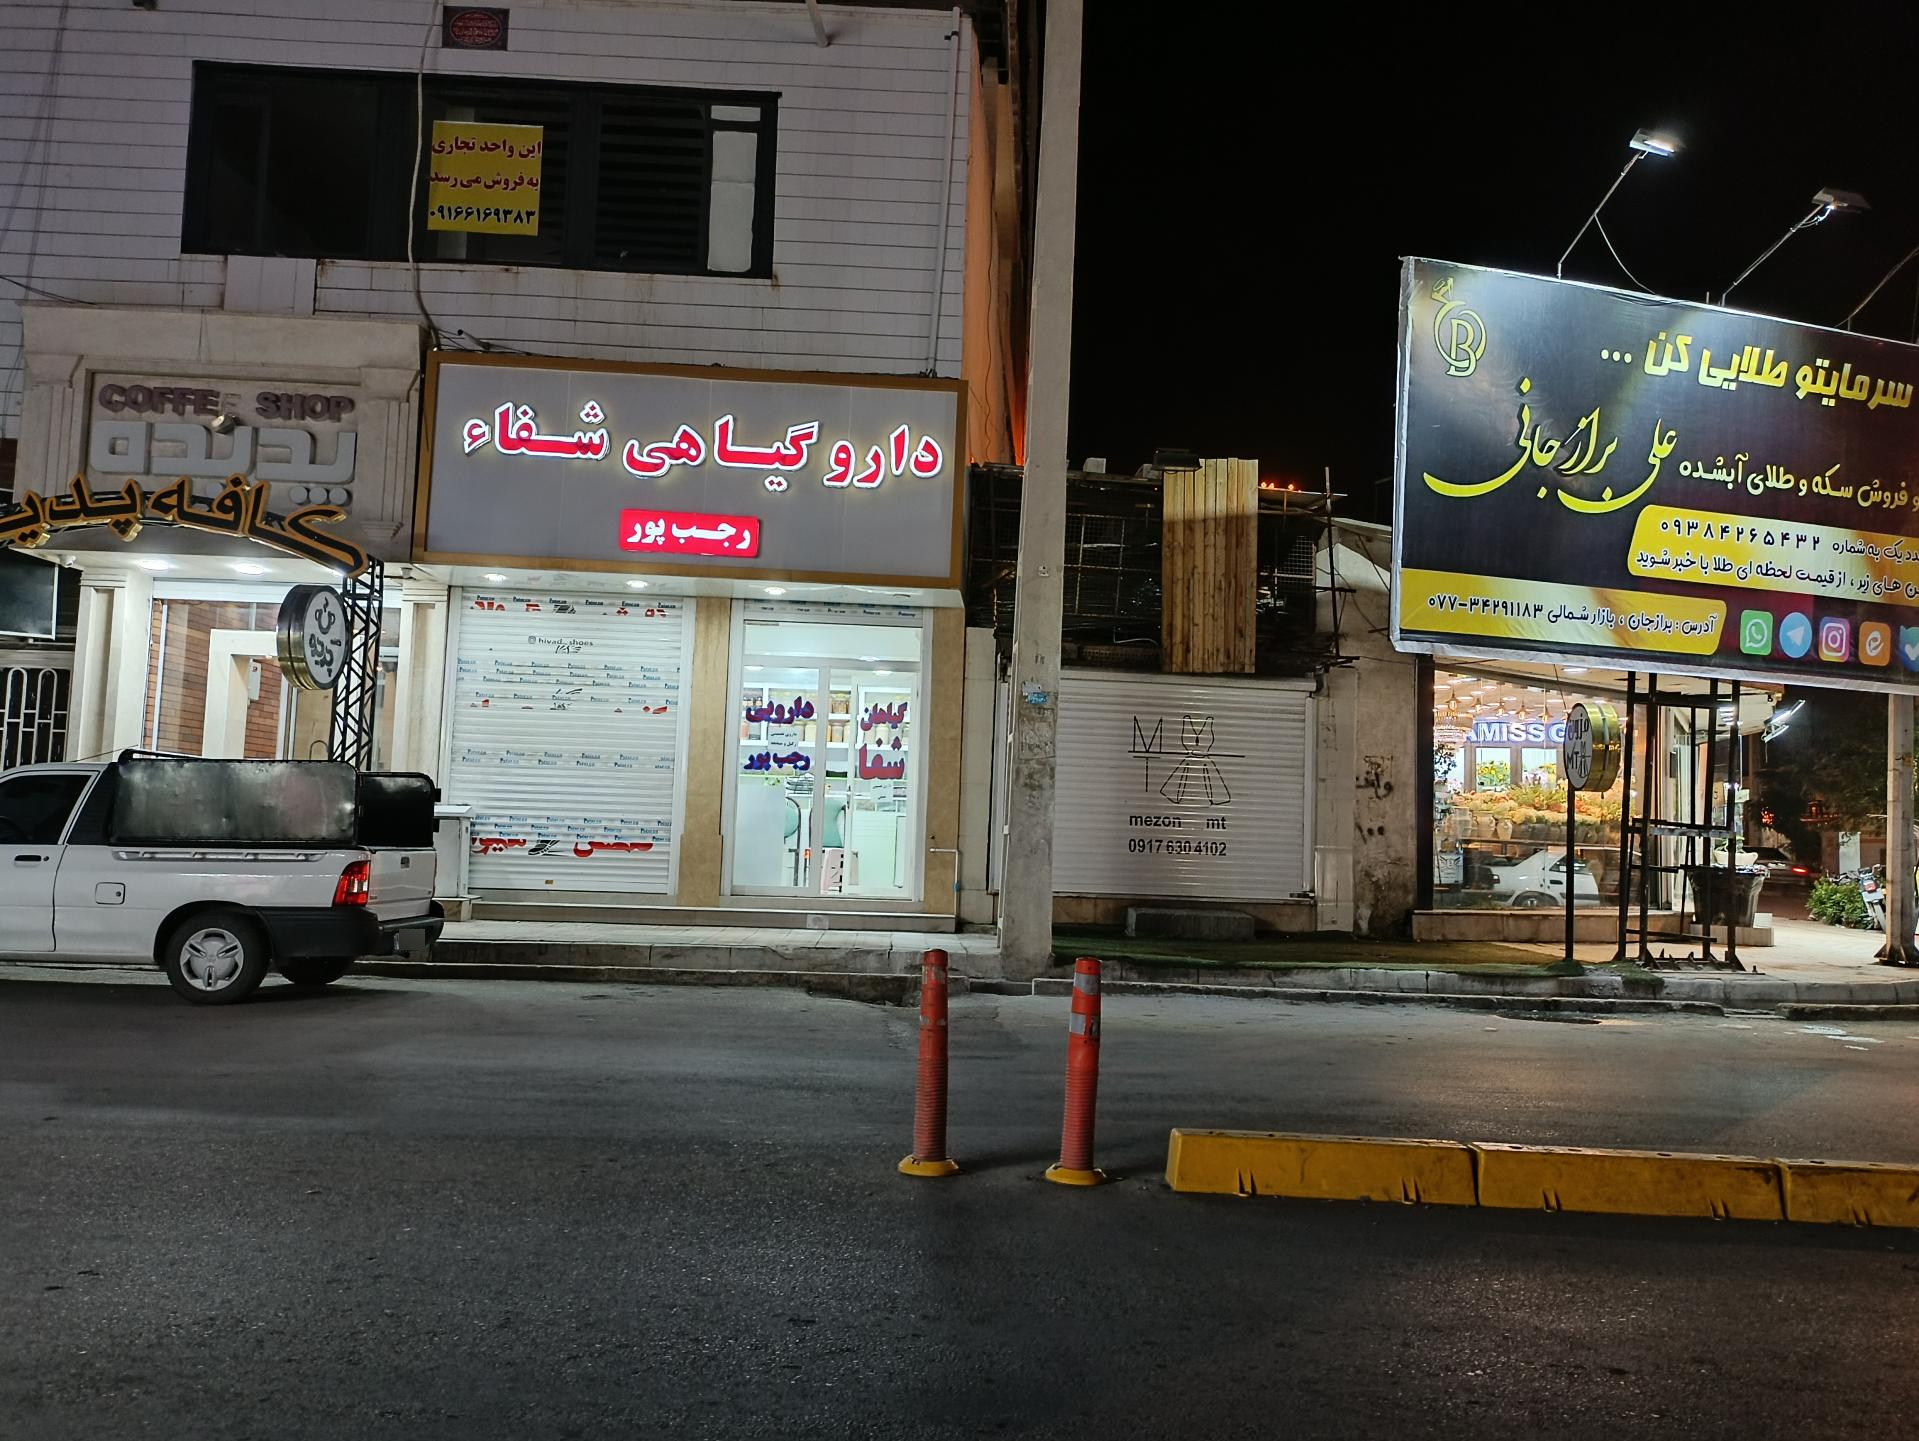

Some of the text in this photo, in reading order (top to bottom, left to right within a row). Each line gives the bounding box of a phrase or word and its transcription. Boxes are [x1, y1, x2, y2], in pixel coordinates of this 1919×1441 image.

[431, 136, 542, 158] این واحد تجاری
[429, 171, 539, 191] به فروش می رسد
[429, 204, 536, 224] ۰۹۱۶۶۱۶۹۳۸۳
[1643, 331, 1693, 377] کن
[1697, 344, 1790, 391] طلایی
[1794, 357, 1914, 410] سرمایتو
[255, 391, 356, 423] SHOP
[462, 399, 611, 461] شفاء
[822, 423, 943, 489] دارو
[1422, 377, 1678, 515] علی برازجانی
[1679, 452, 1749, 490] آبشده
[1746, 464, 1795, 496] طلای
[1811, 463, 1853, 498] سکه
[1798, 478, 1808, 497] و
[1857, 479, 1909, 509] فروش
[147, 472, 369, 579] کافه
[626, 518, 751, 549] رجب پور
[1832, 538, 1866, 555] شماره
[1867, 544, 1880, 561] به
[1883, 539, 1904, 563] یک
[1635, 549, 1671, 568] شوید
[1672, 551, 1696, 572] خبر
[1700, 555, 1709, 575] با
[1713, 556, 1733, 572] طلا
[1755, 560, 1793, 579] لحظه
[1795, 569, 1835, 587] قیمت
[1836, 571, 1846, 588] از
[1872, 576, 1901, 595] های
[1547, 605, 1589, 624] شمالی
[1591, 606, 1616, 628] بازار
[745, 695, 908, 731] گیاهان دارویی
[772, 751, 811, 771] رجب
[858, 736, 905, 780] شفا
[1129, 815, 1227, 830] mezon mt
[1128, 838, 1163, 853] 0917
